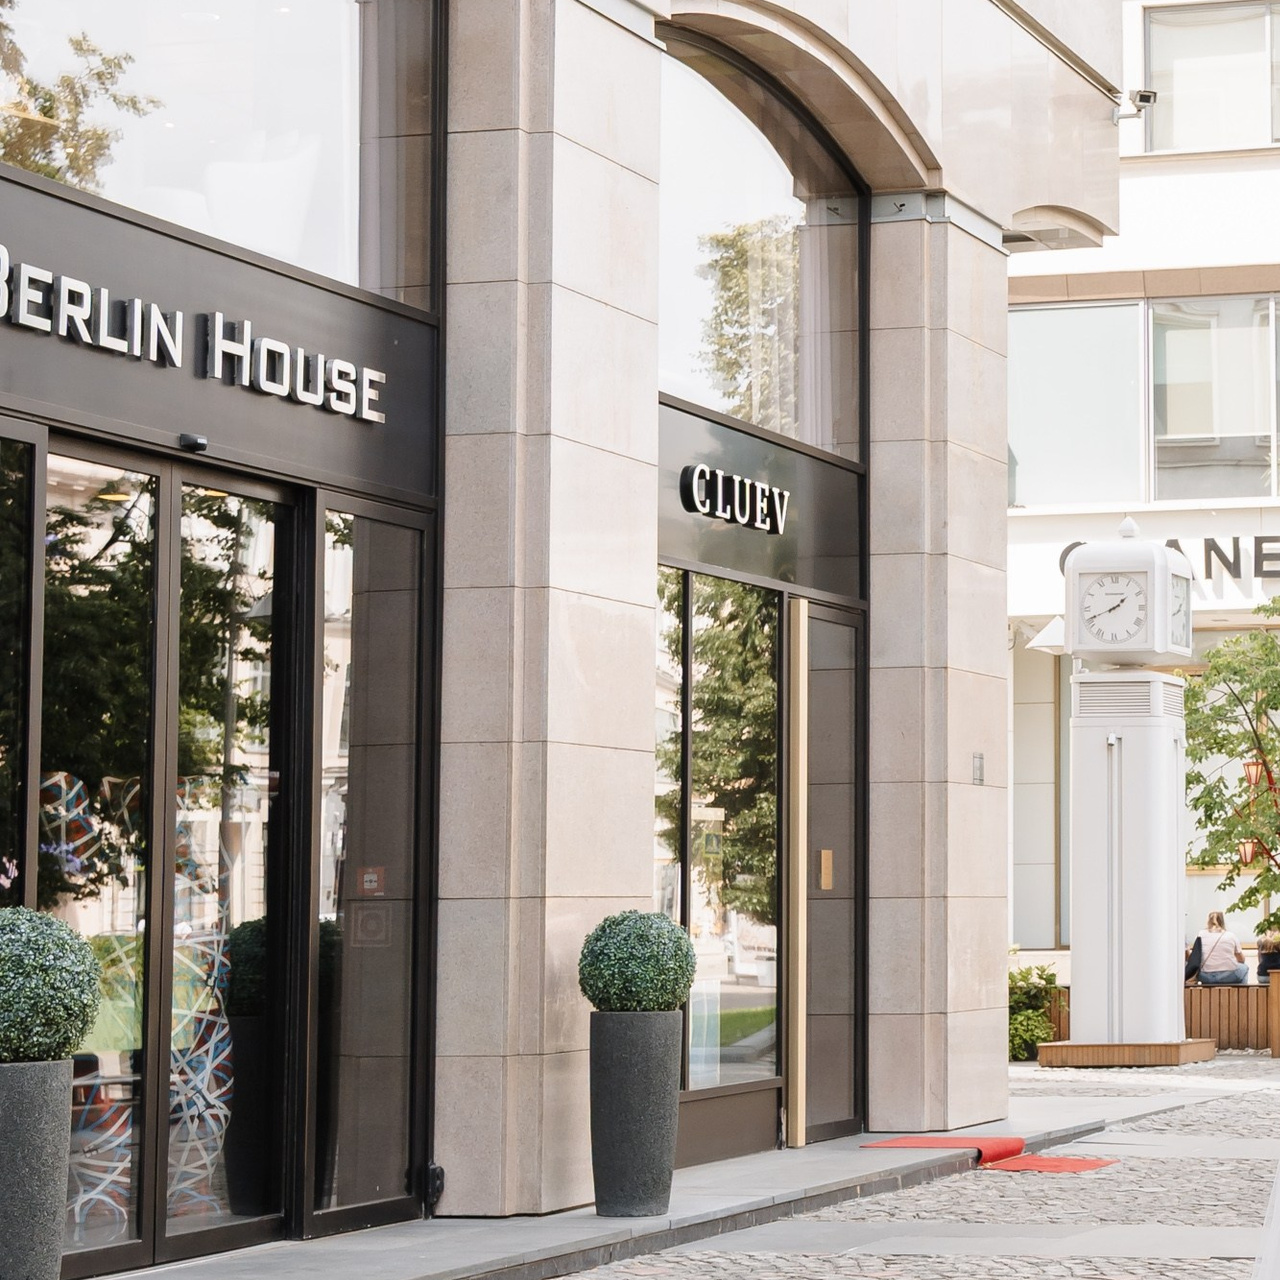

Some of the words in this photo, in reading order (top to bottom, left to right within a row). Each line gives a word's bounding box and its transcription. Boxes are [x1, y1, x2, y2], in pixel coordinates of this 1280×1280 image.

[0, 244, 184, 368] ERLIN
[206, 310, 387, 424] HOUSE
[691, 463, 791, 536] CLUEV
